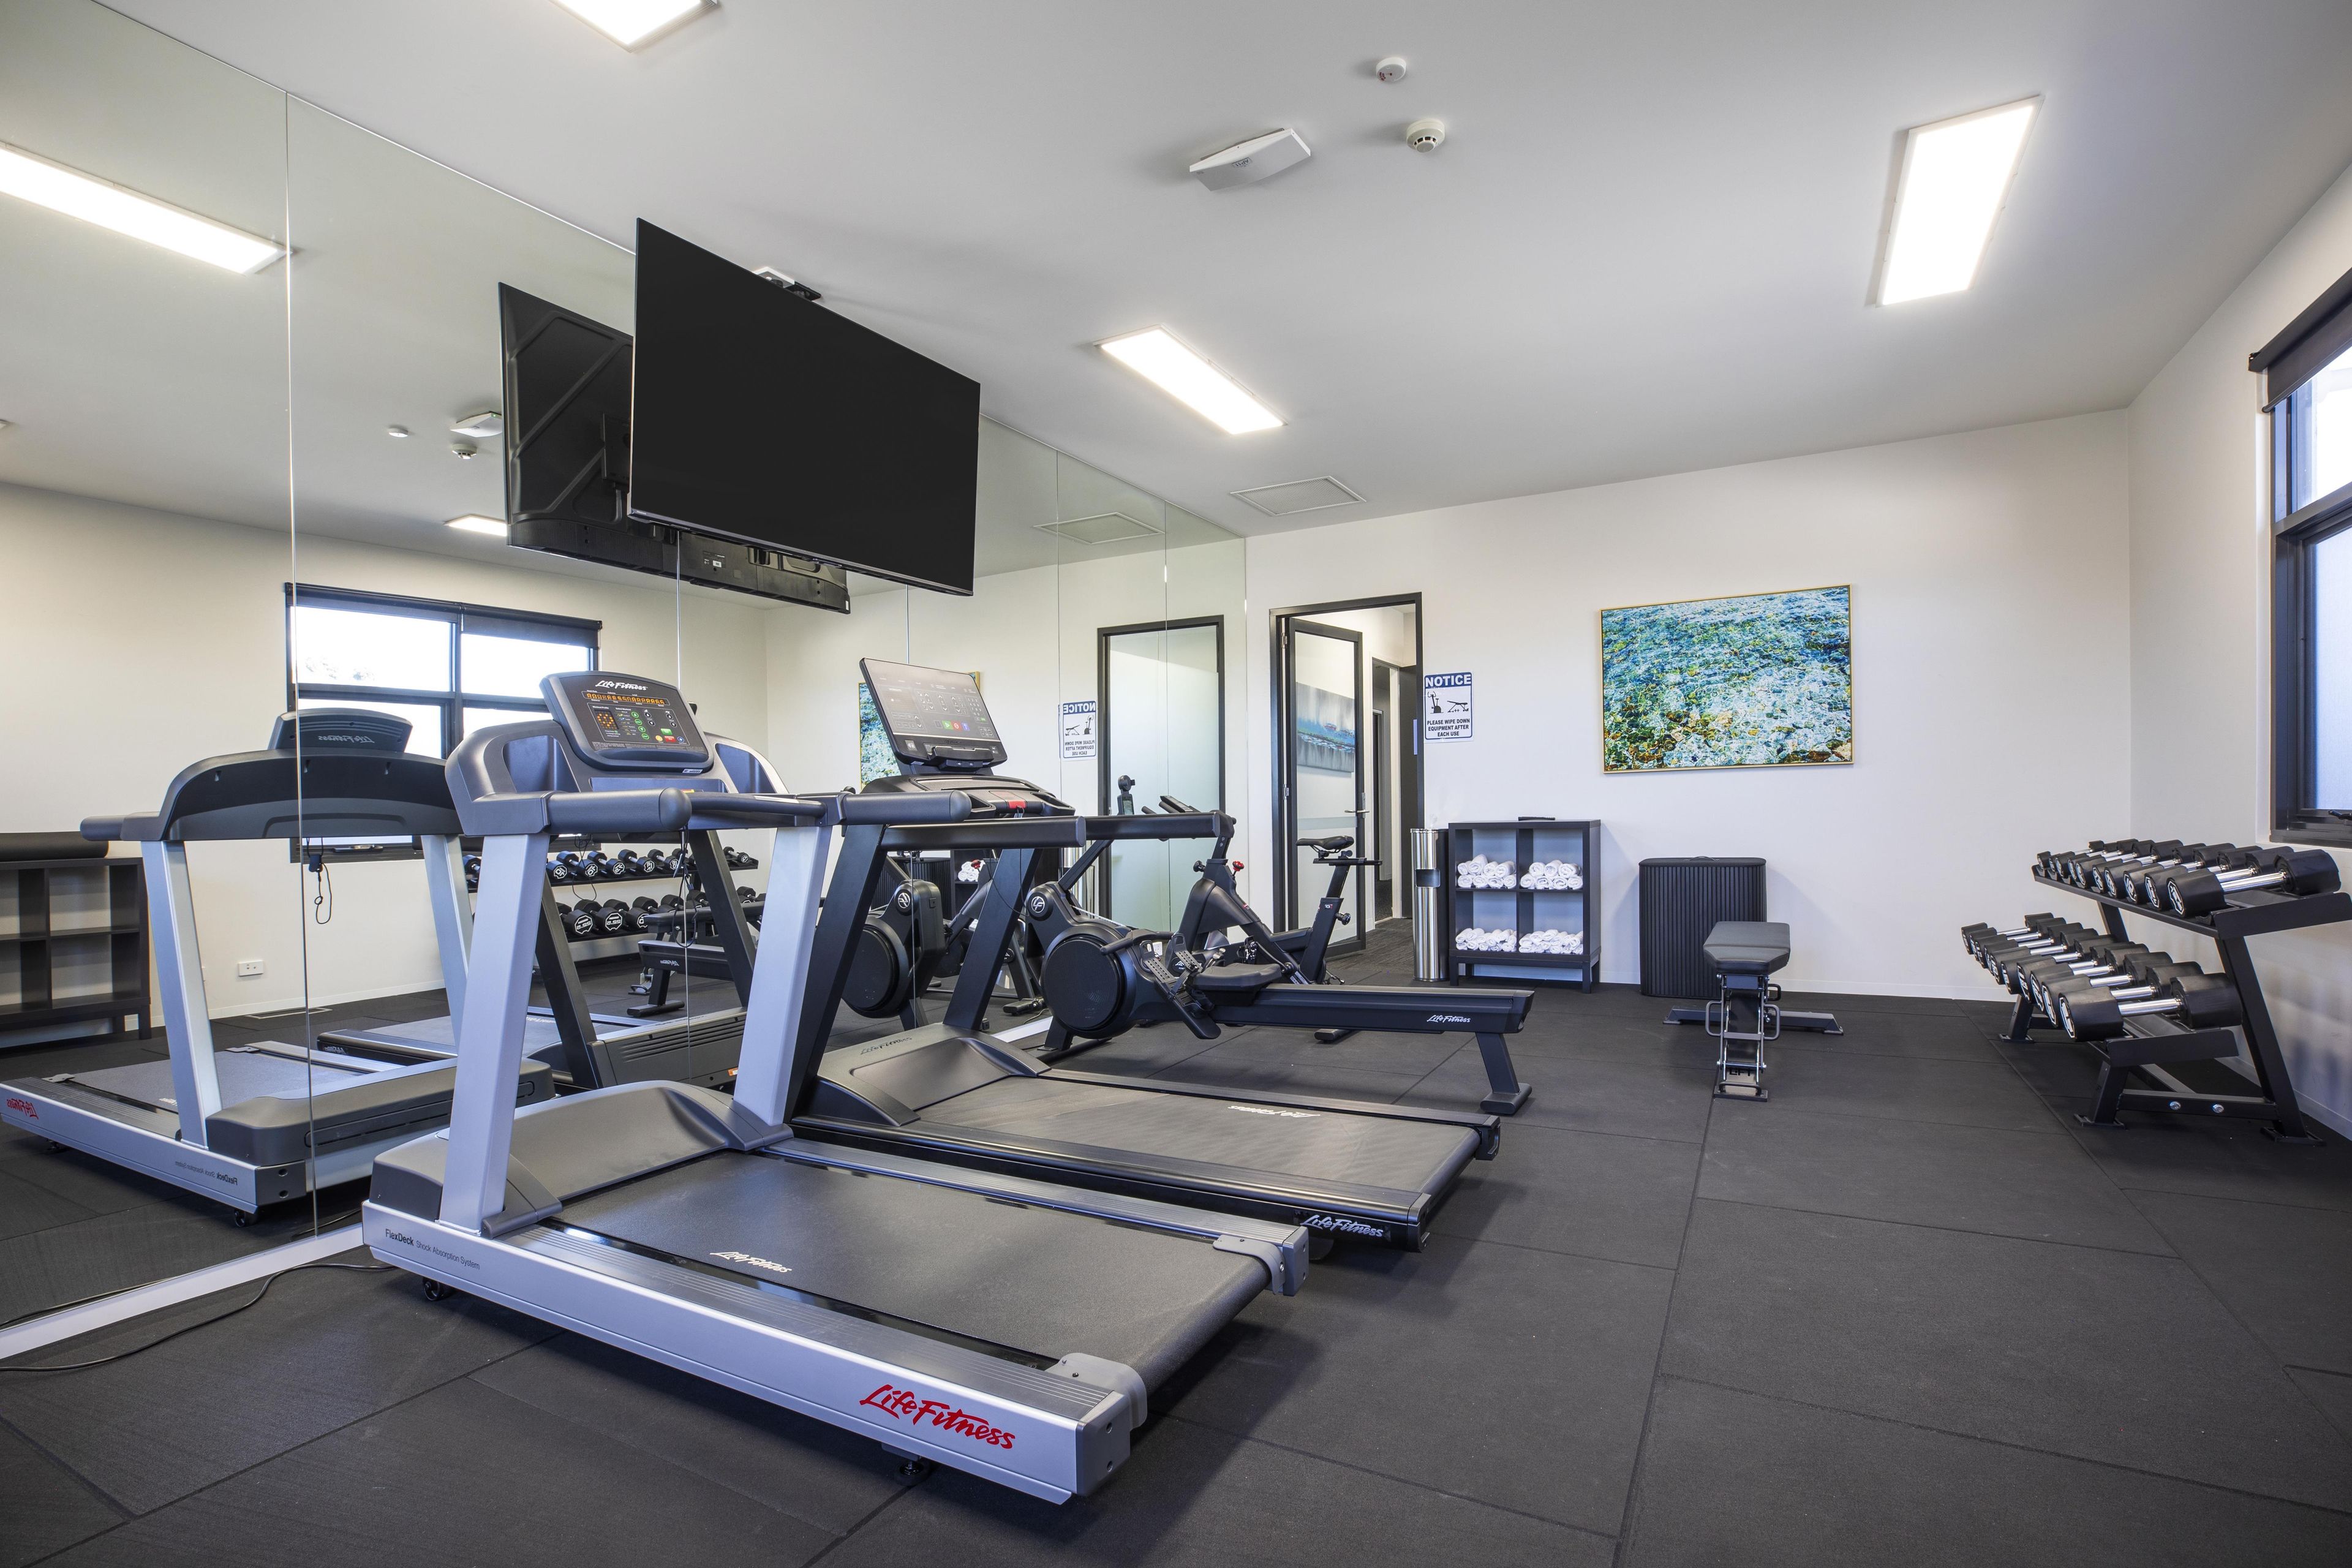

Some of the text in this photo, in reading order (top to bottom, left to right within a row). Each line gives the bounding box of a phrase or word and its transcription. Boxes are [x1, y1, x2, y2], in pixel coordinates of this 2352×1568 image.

[614, 682, 647, 691] Fitness
[1425, 674, 1471, 687] NOTICE
[1427, 1014, 1444, 1023] Life
[1300, 1215, 1384, 1237] Life Fitness
[385, 1228, 480, 1270] FlexDeck Shock Absorption System
[859, 1384, 1016, 1449] Life Fitness
